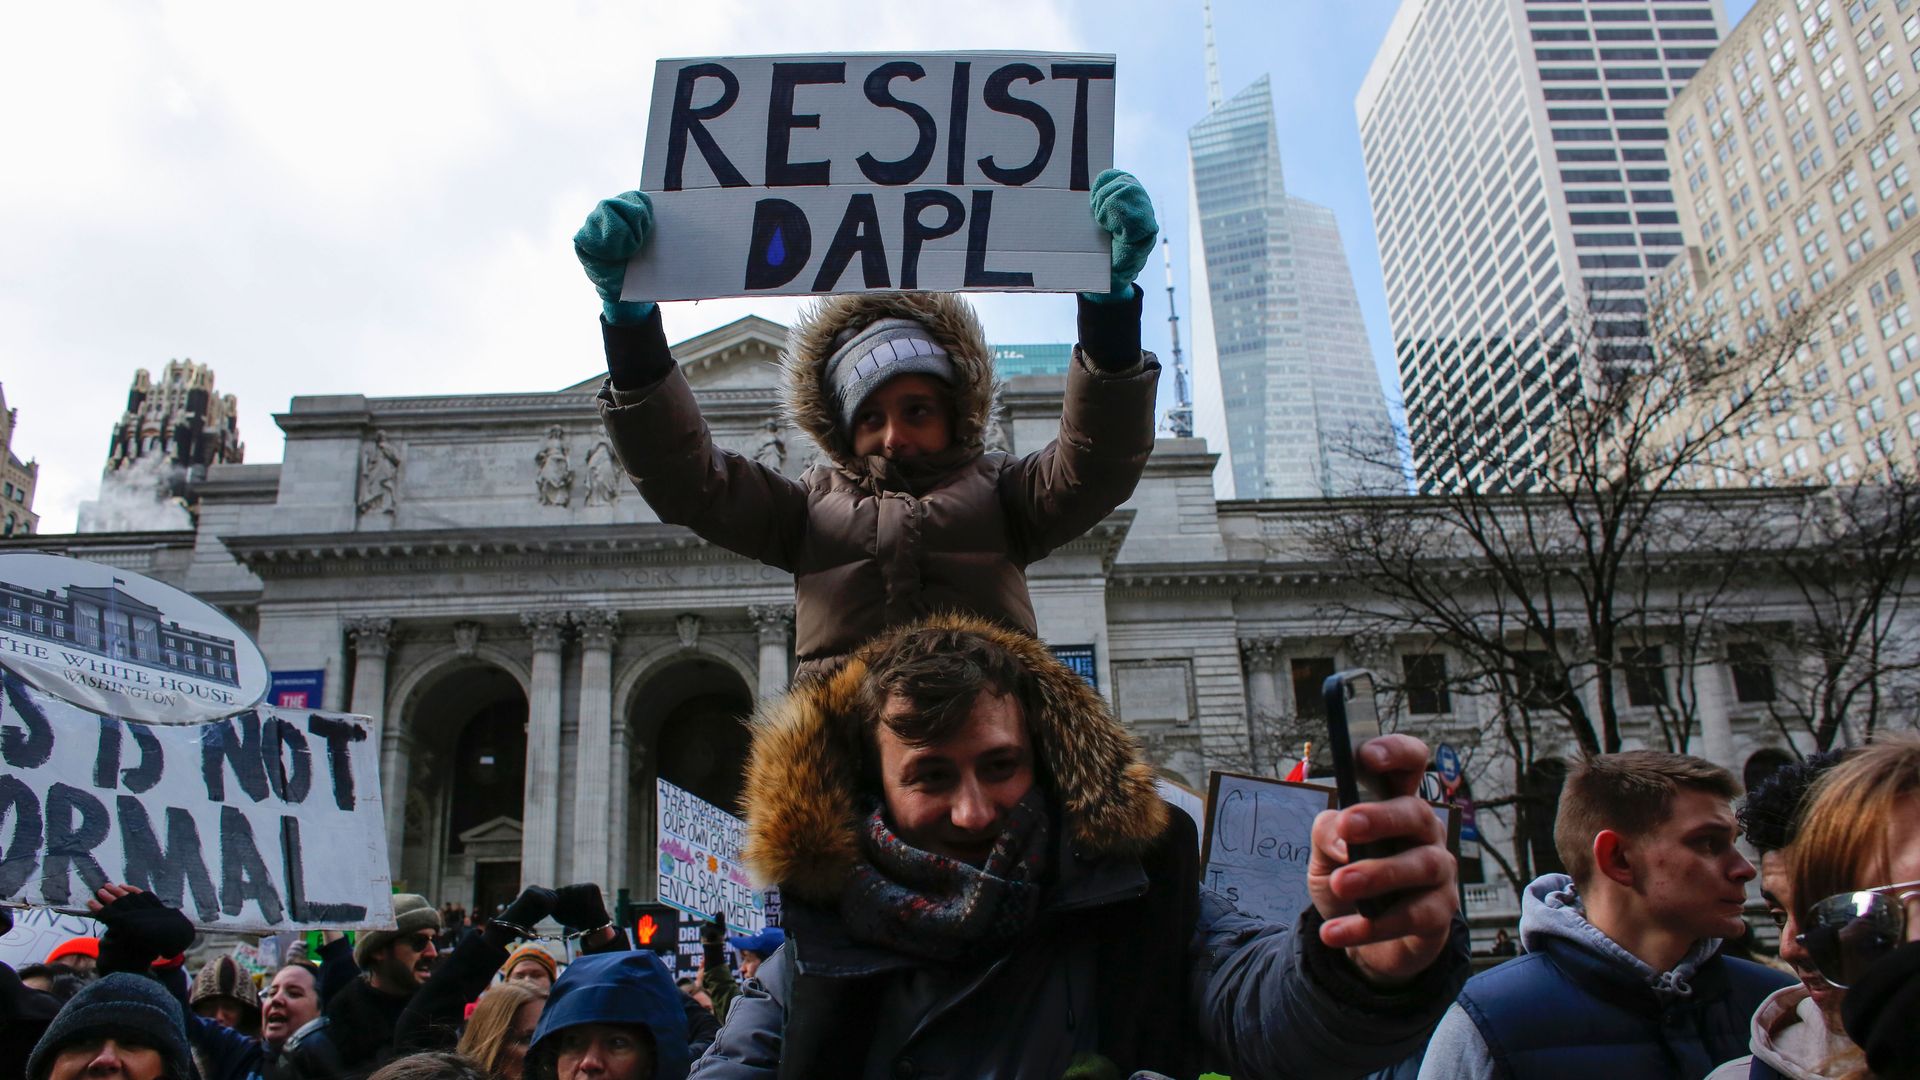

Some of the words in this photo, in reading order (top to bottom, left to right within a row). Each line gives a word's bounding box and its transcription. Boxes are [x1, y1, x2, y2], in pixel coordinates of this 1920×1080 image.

[663, 61, 1115, 191] RESIST
[744, 189, 1034, 291] DAPL
[486, 574, 530, 589] THE
[548, 573, 599, 588] NEW
[621, 570, 682, 586] YORK
[697, 566, 773, 583] PUBLIC
[0, 636, 49, 660] THE
[60, 651, 150, 685] WHITE
[159, 676, 236, 706] HOUSE
[63, 669, 177, 707] WASHINGTON
[283, 695, 304, 708] THE
[93, 716, 164, 794] IS
[201, 709, 367, 812] NOT
[664, 798, 689, 819] THAT
[692, 812, 705, 827] WE
[706, 818, 725, 836] HAVE
[664, 811, 686, 838] OUR
[688, 823, 708, 847] OWN
[1219, 789, 1309, 865] Clean
[660, 875, 763, 931] ENVIRONMENT
[675, 857, 694, 884] TO
[698, 870, 728, 898] SAVE
[729, 881, 752, 906] THE
[679, 927, 700, 942] DRI
[679, 943, 704, 955] TRUM
